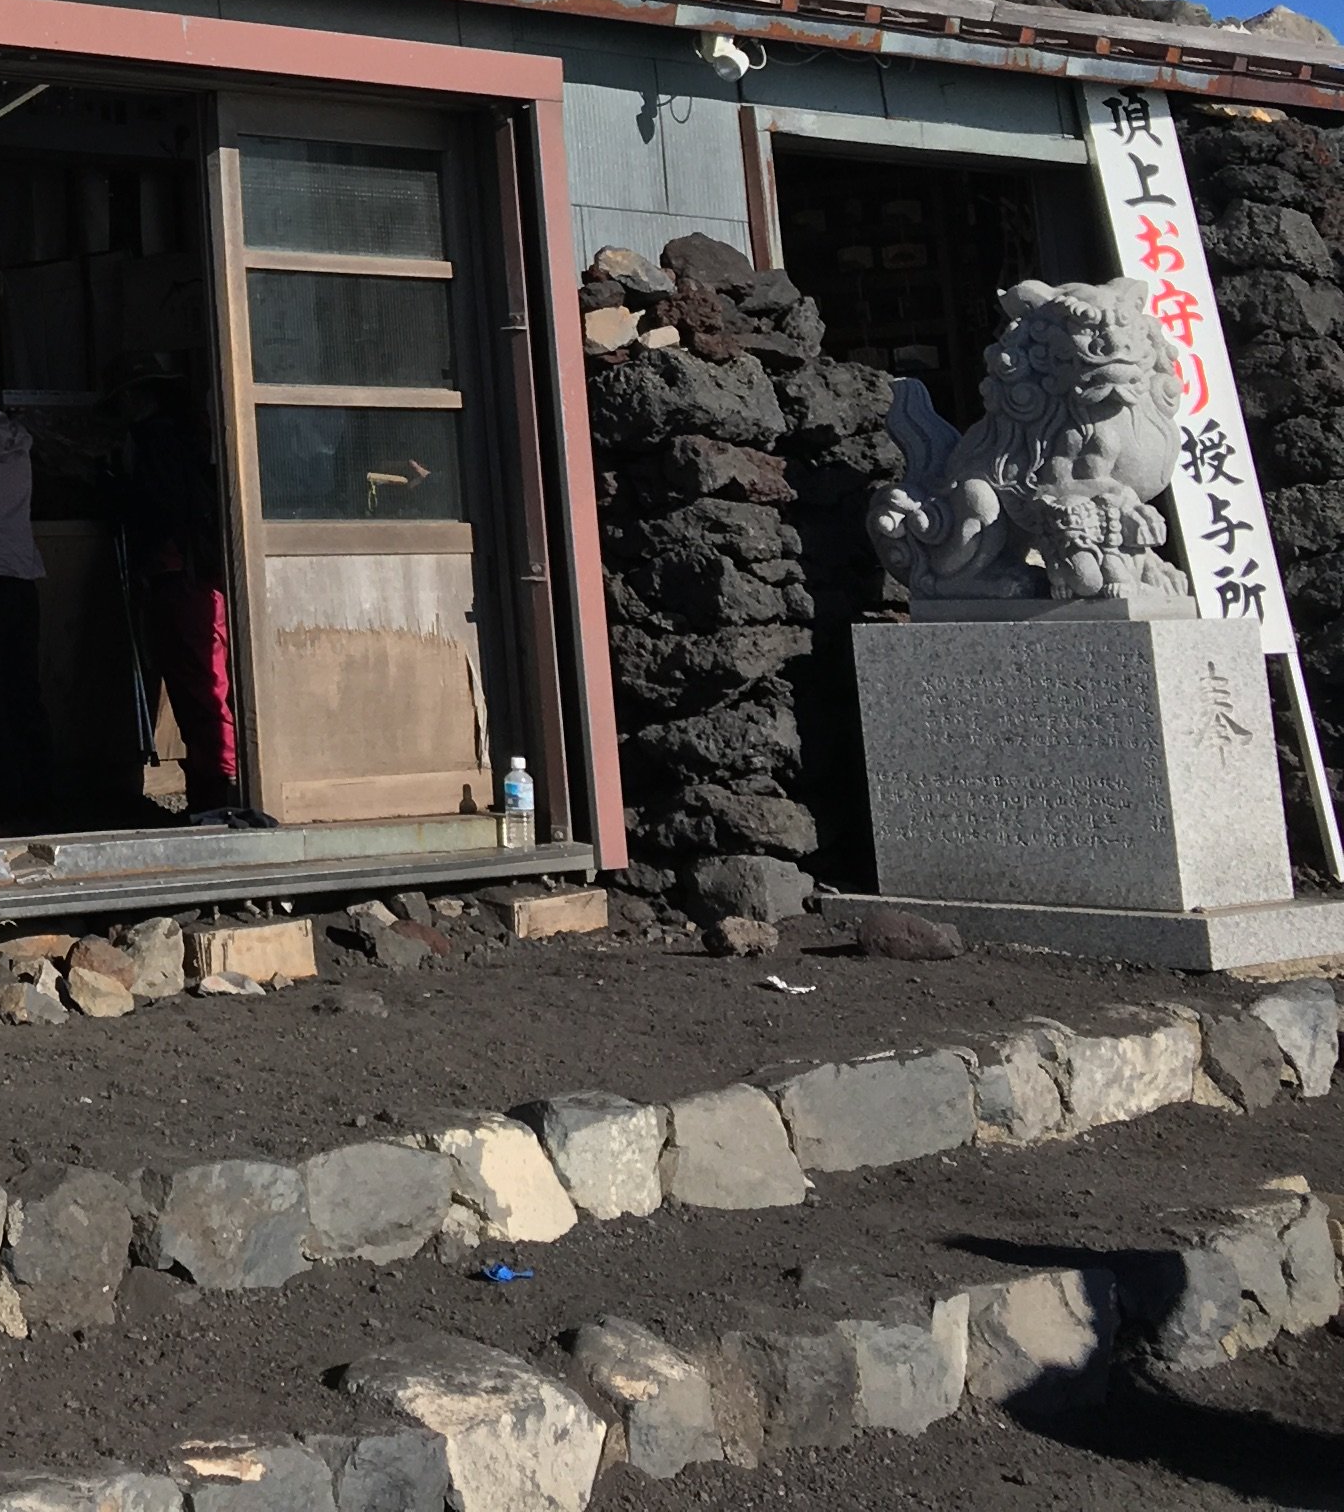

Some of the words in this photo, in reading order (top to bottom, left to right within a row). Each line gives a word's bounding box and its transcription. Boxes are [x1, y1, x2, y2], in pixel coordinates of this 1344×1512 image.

[1103, 88, 1267, 626] 頂上お守り授与所
[1181, 660, 1254, 769] 奉
